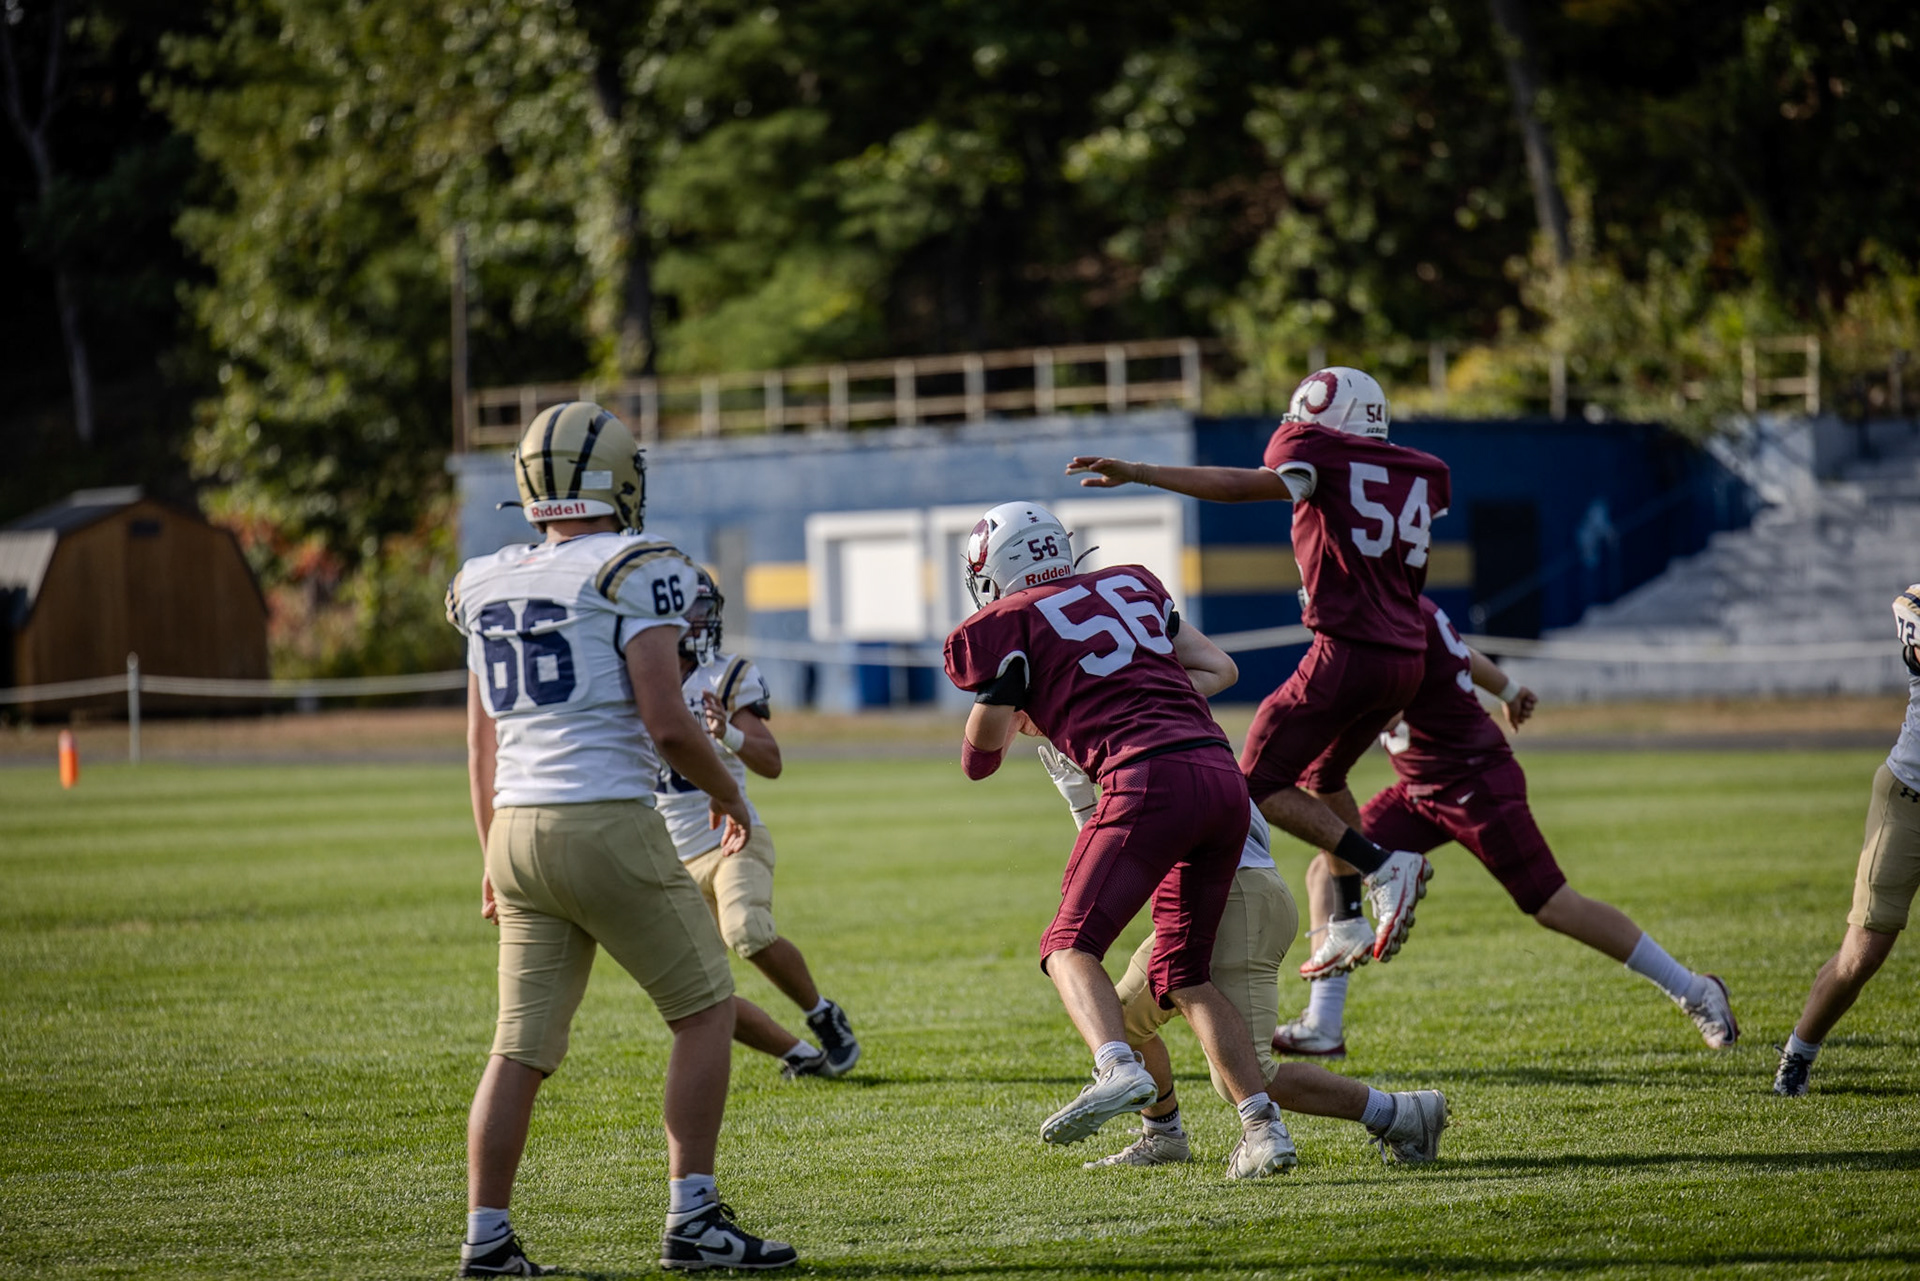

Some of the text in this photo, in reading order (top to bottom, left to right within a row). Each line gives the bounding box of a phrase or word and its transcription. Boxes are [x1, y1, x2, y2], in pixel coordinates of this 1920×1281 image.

[1366, 404, 1382, 423] 54
[531, 503, 586, 517] Riddell
[1349, 461, 1431, 568] 54
[1025, 565, 1070, 585] Riddell
[653, 575, 684, 616] 66
[1034, 574, 1174, 677] 56
[1898, 616, 1916, 646] 72
[479, 598, 577, 712] 66
